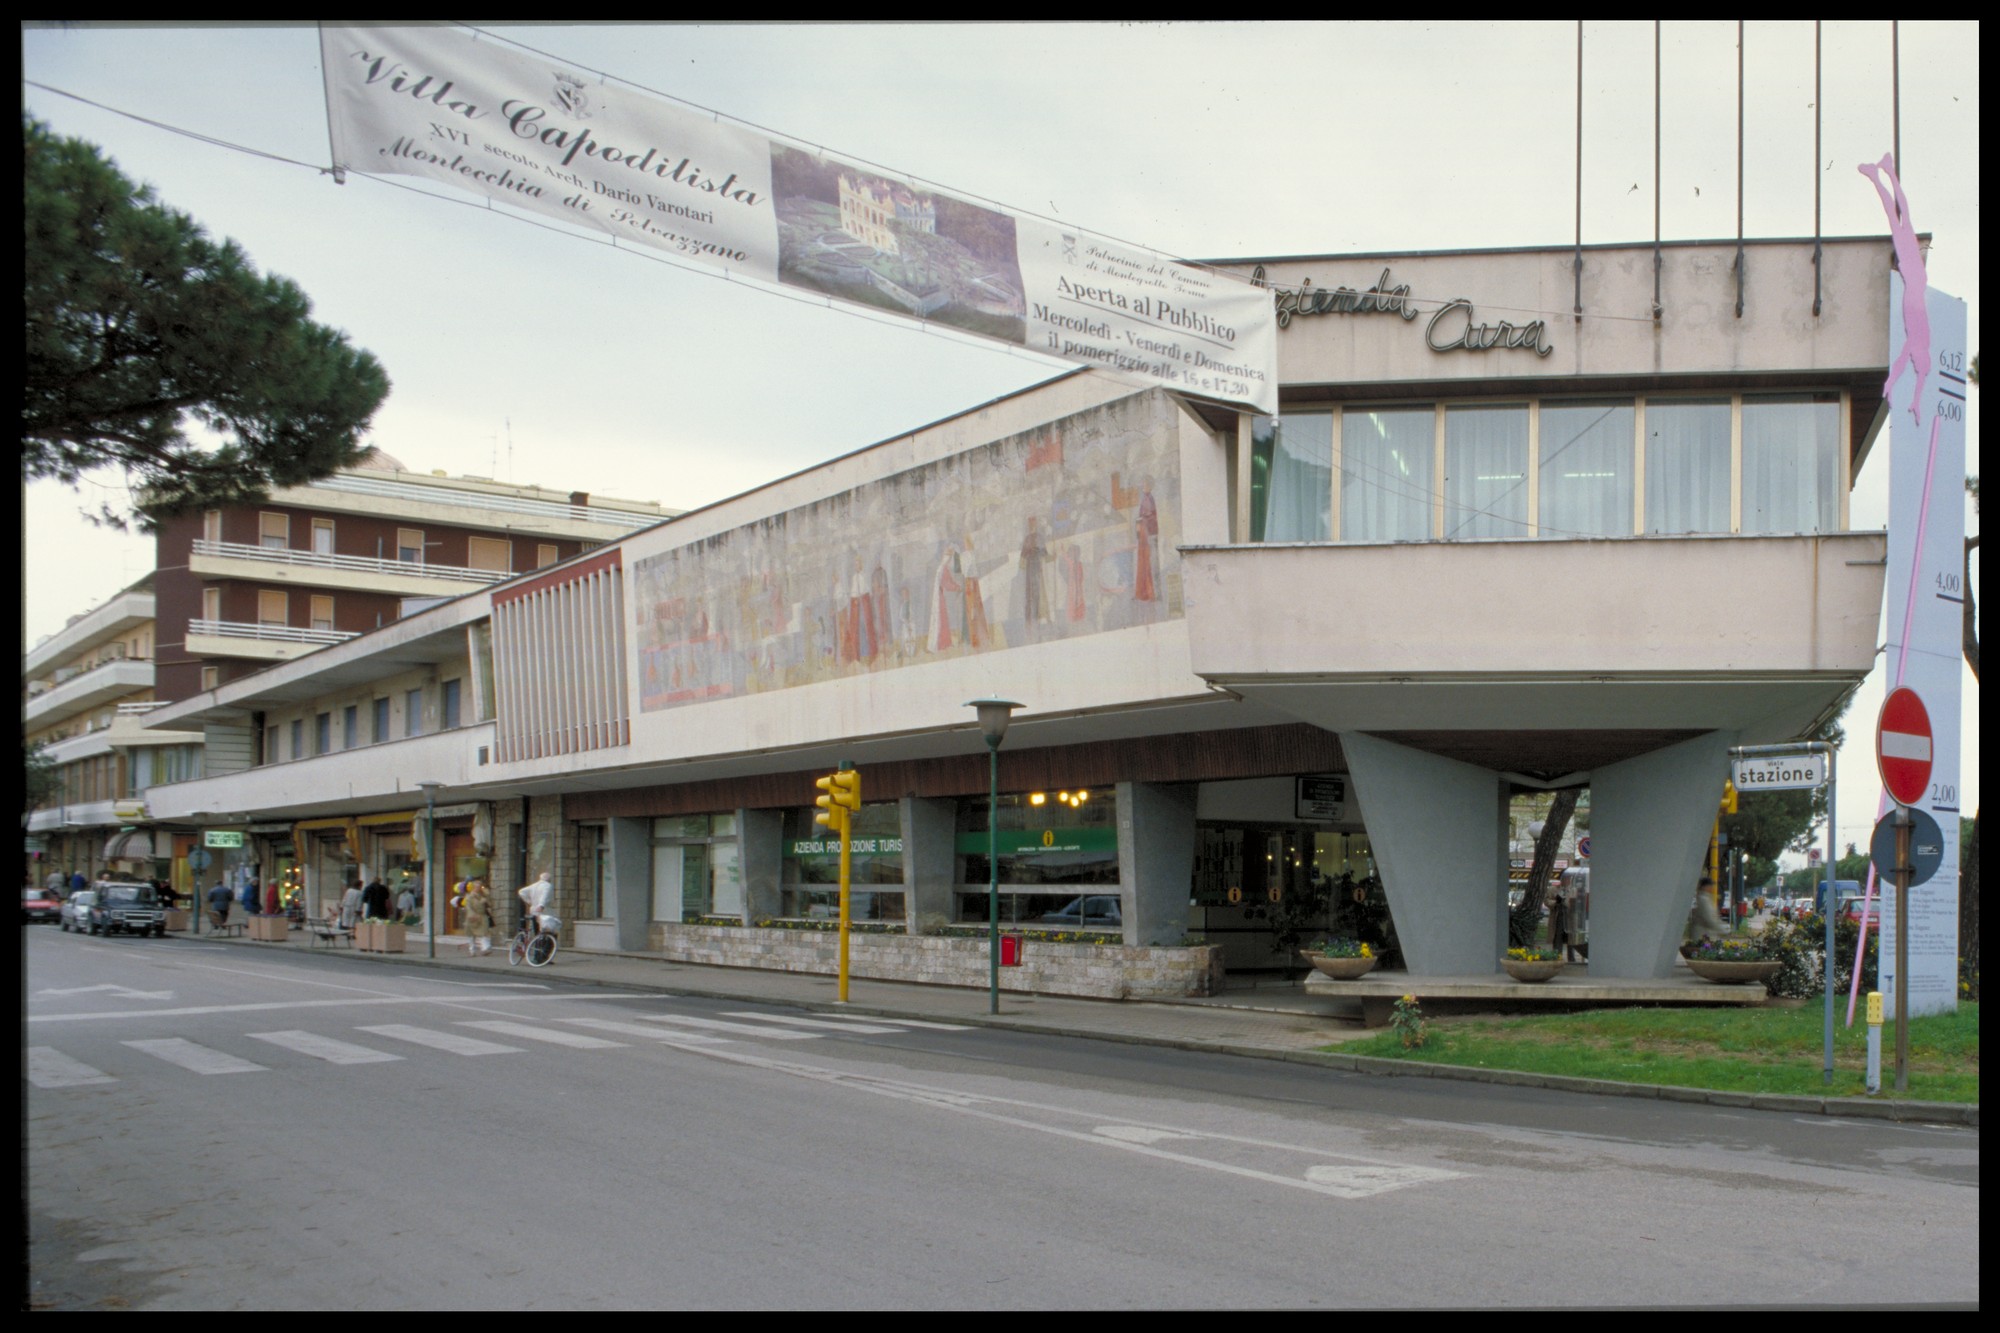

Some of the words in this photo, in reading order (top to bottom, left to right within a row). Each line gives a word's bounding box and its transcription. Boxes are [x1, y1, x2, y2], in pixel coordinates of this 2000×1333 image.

[351, 50, 490, 119] Villa
[501, 100, 765, 206] Capodilista
[429, 122, 471, 146] XVI
[483, 142, 540, 170] secolo
[543, 166, 588, 191] Arch.
[593, 180, 642, 206] Dario
[647, 194, 714, 225] Varotari
[379, 136, 547, 199] Montecchia
[563, 192, 592, 212] di
[610, 208, 752, 263] Selvazzano
[1085, 246, 1142, 270] Patrocinio
[1147, 264, 1164, 276] del
[1169, 268, 1211, 288] Comune
[1086, 261, 1097, 271] di
[1103, 266, 1168, 289] Montegrotto
[1057, 275, 1128, 309] Aperta
[1134, 296, 1151, 316] al
[1157, 300, 1236, 342] Pubblico
[1425, 298, 1553, 358] Cura
[1032, 302, 1111, 340] Mercoledì
[1184, 351, 1192, 363] e
[1194, 350, 1265, 381] Domenica
[1048, 331, 1059, 349] il
[1063, 340, 1149, 373] pomeriggio
[1151, 363, 1178, 381] alle
[1202, 378, 1210, 389] e
[1940, 349, 1961, 371] 6,12
[1938, 400, 1961, 422] 6,00
[1936, 572, 1959, 592] 4,00
[1740, 766, 1814, 783] stazione
[1932, 783, 1955, 804] 2,00
[794, 841, 824, 853] AZIENDA
[827, 840, 876, 853] PROZIONE
